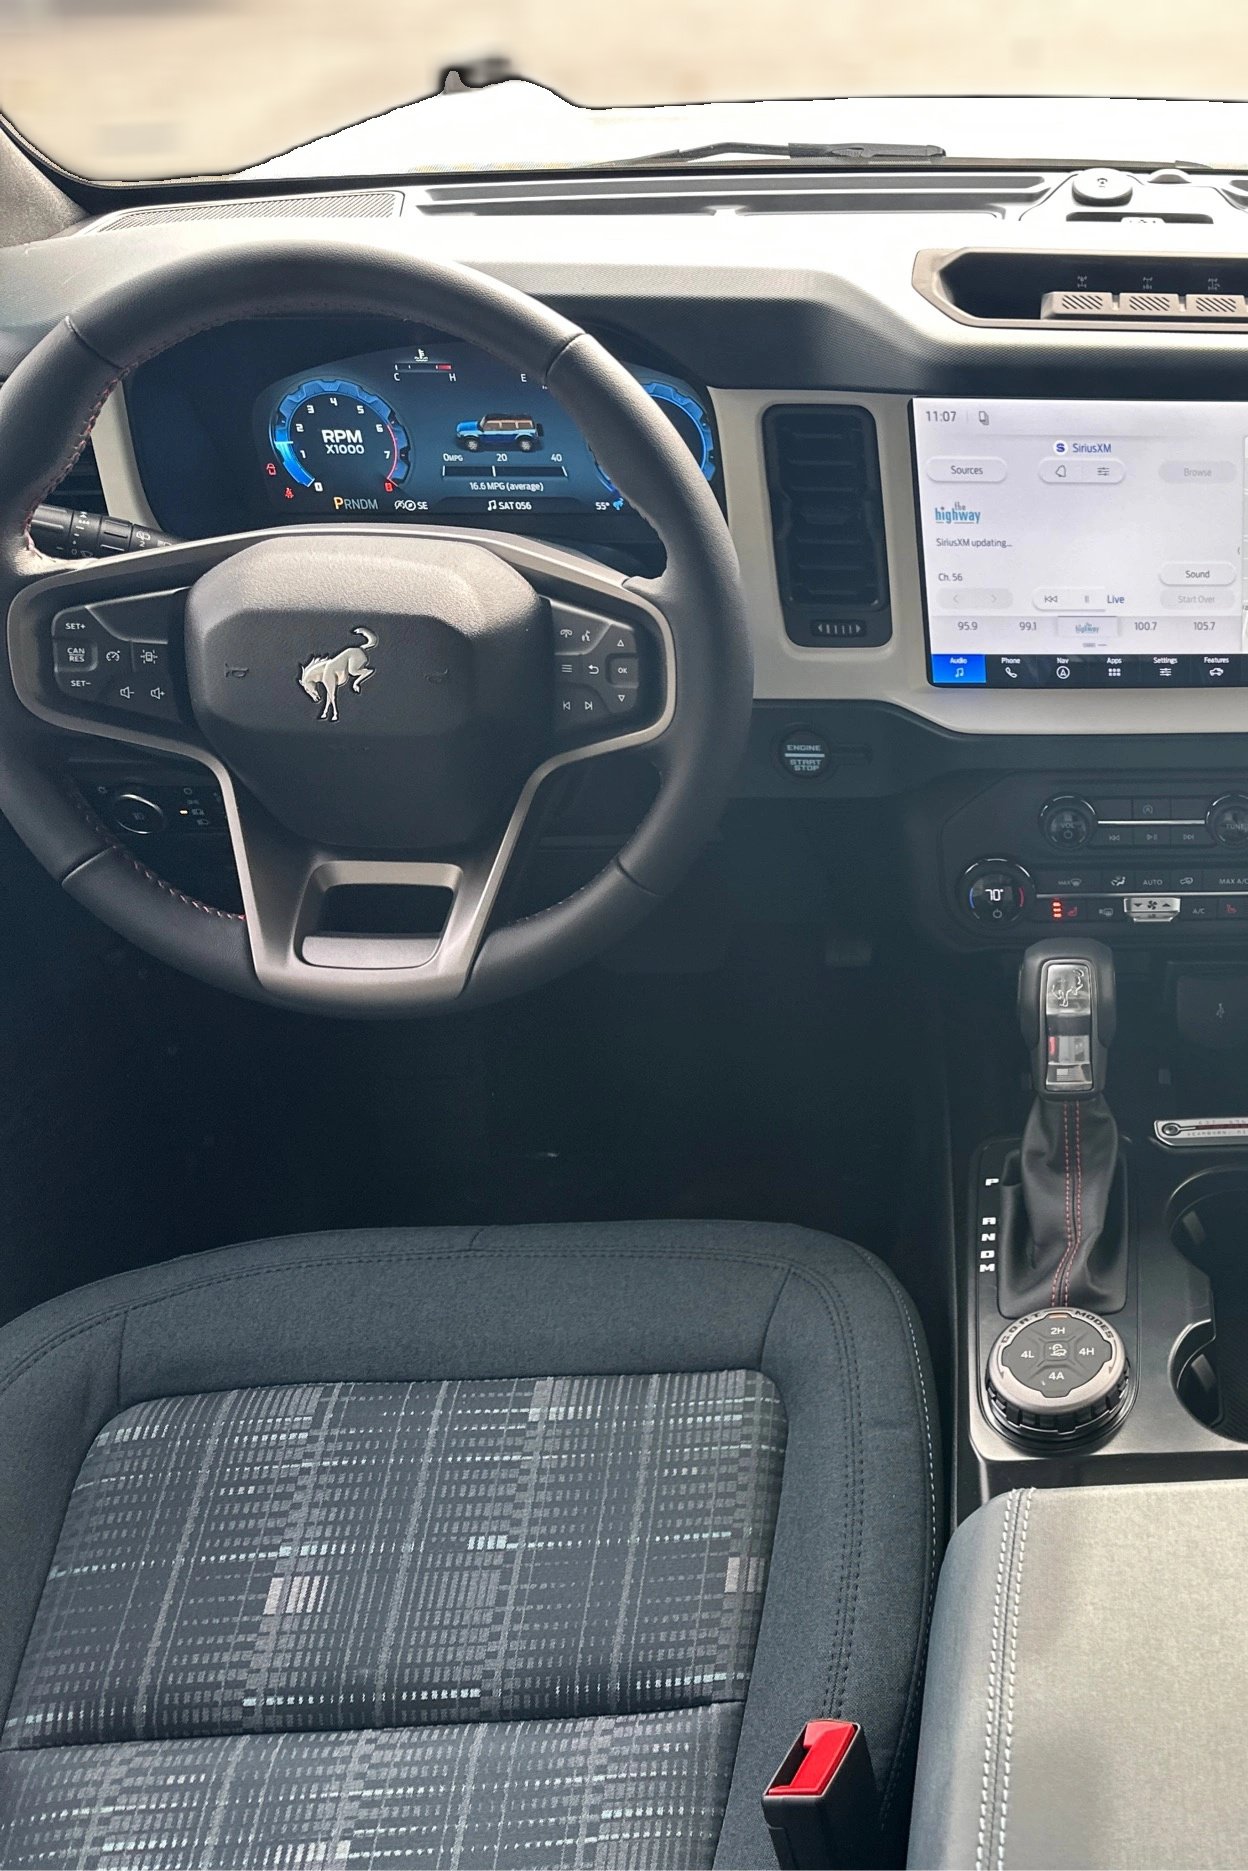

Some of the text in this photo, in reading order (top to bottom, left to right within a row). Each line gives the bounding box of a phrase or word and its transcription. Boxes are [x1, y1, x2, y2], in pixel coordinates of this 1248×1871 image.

[394, 373, 400, 381] C
[449, 373, 456, 382] H
[521, 374, 527, 383] E
[330, 398, 338, 406] 4
[307, 405, 315, 414] 3
[357, 405, 364, 414] 5
[925, 411, 956, 422] 11:07
[296, 424, 304, 432] 2
[376, 424, 383, 432] 6
[322, 429, 363, 443] RPM
[1073, 443, 1111, 453] SiriusXM
[384, 451, 390, 459] 7
[497, 454, 507, 462] 20
[551, 454, 562, 462] 40
[950, 466, 983, 475] Sources
[1183, 468, 1212, 477] Browse
[506, 482, 544, 492] (average)
[499, 502, 532, 510] SAT 056
[935, 506, 981, 524] highway
[936, 538, 970, 547] SiriusXM
[952, 573, 963, 581] 56
[1186, 570, 1210, 578] Sound
[1107, 595, 1125, 604] Live
[1177, 595, 1215, 603] Start Over
[958, 621, 978, 631] 95.9
[1019, 622, 1037, 631] 99.1
[1134, 622, 1157, 631] 100.7
[1193, 622, 1215, 631] 105.7
[1107, 657, 1122, 665] Apps
[1153, 656, 1178, 665] Settings
[985, 1178, 999, 1186] P
[981, 1233, 996, 1241] N
[980, 1250, 995, 1259] D
[979, 1263, 995, 1272] M
[1074, 1311, 1114, 1338] MODES
[1020, 1350, 1035, 1358] 4L
[1078, 1347, 1095, 1356] 4H
[1048, 1372, 1064, 1380] 4A
